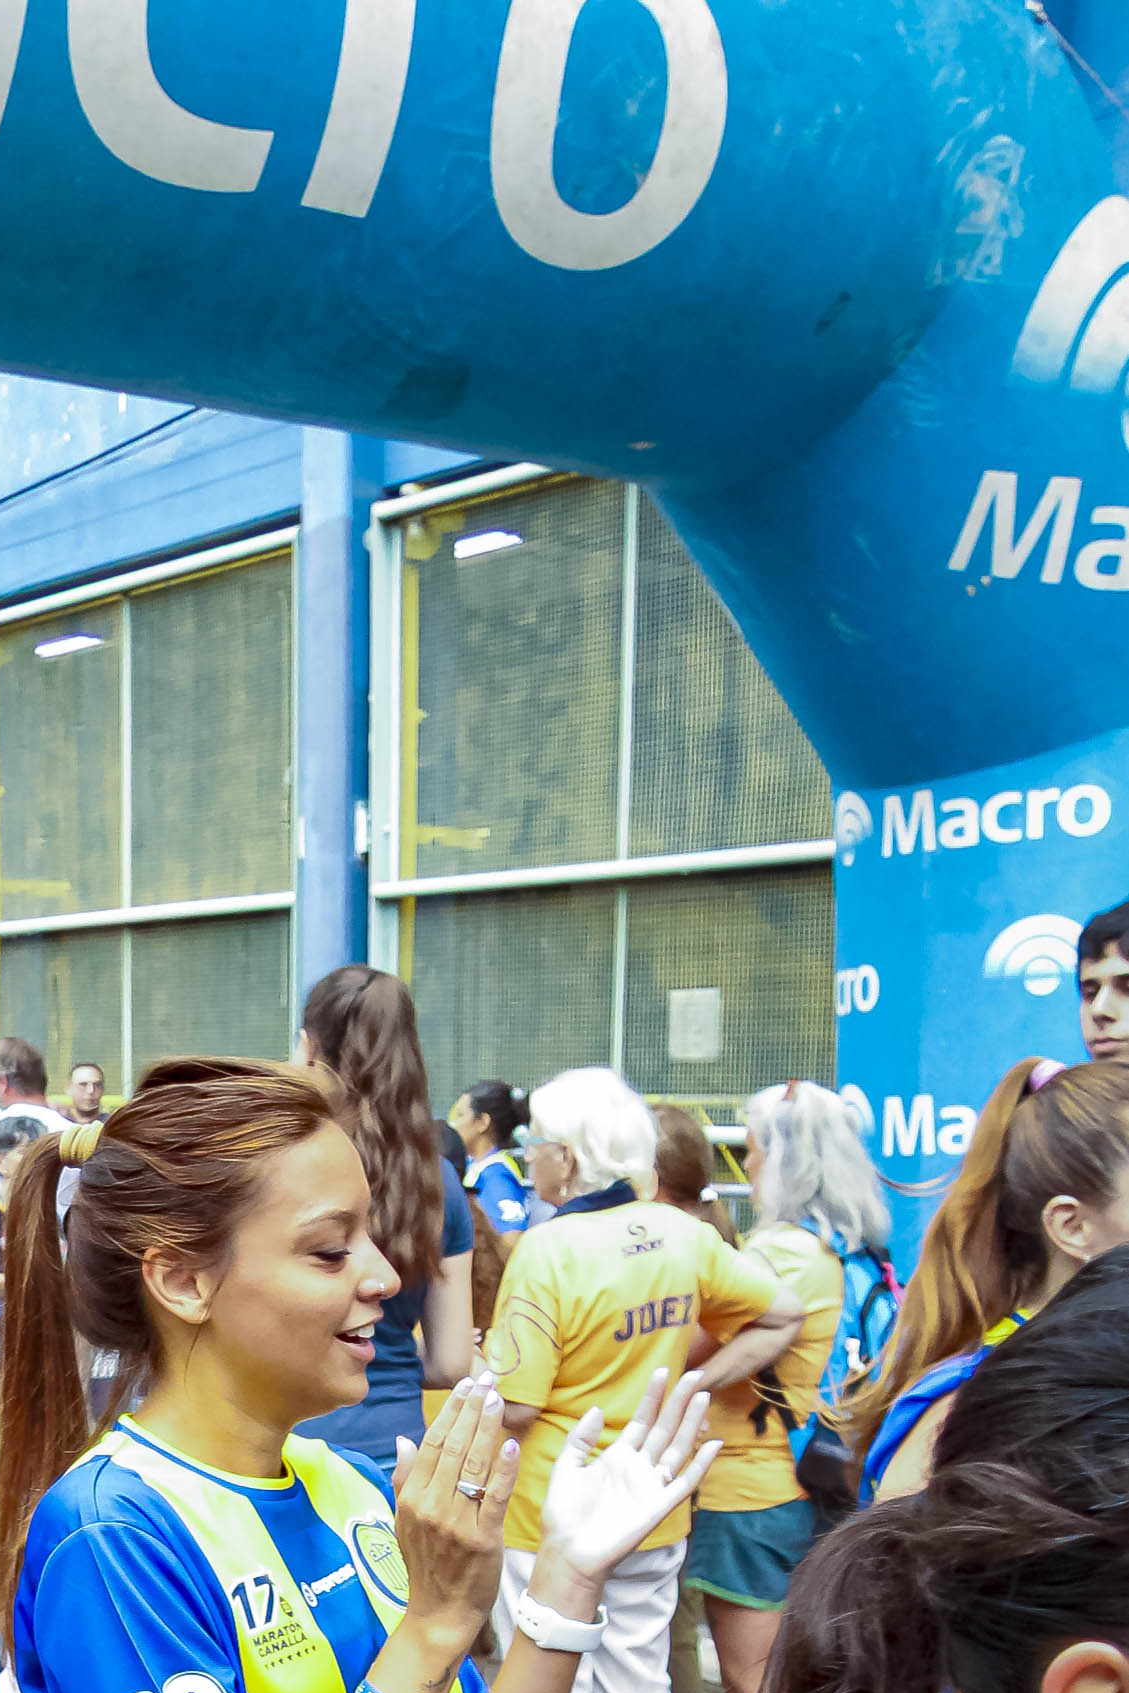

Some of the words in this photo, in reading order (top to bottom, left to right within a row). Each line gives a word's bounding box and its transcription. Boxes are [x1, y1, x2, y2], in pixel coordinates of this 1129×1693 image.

[881, 784, 1111, 858] Macro
[835, 964, 880, 1016] ro
[614, 1293, 693, 1342] JUEZ
[230, 1573, 277, 1631] 17
